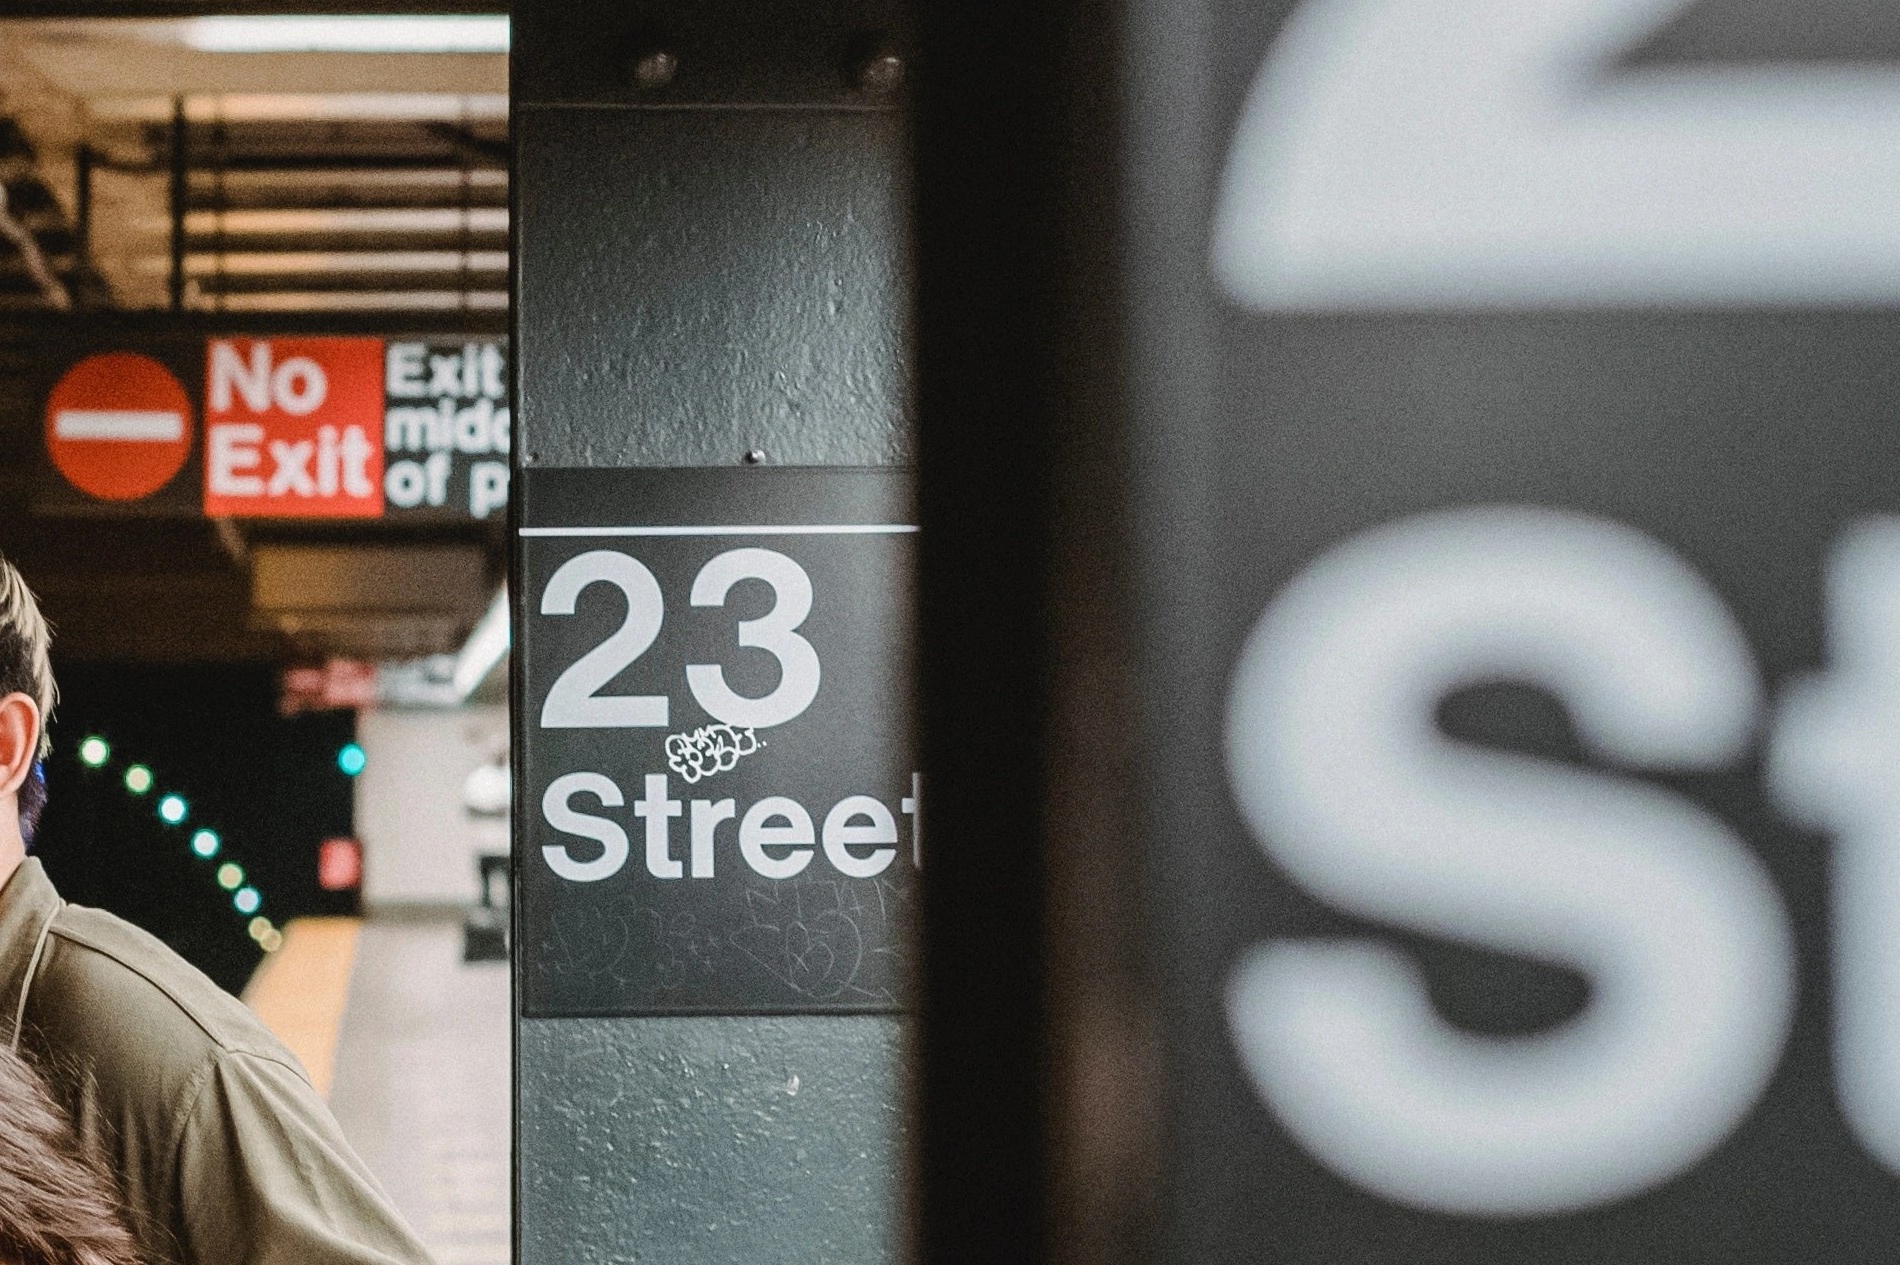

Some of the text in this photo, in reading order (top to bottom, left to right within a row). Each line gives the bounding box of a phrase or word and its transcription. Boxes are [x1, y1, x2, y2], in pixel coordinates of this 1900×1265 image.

[209, 340, 327, 416] No
[386, 342, 505, 398] Exit
[208, 424, 375, 498] Exit
[385, 451, 449, 508] of
[540, 547, 821, 729] 23
